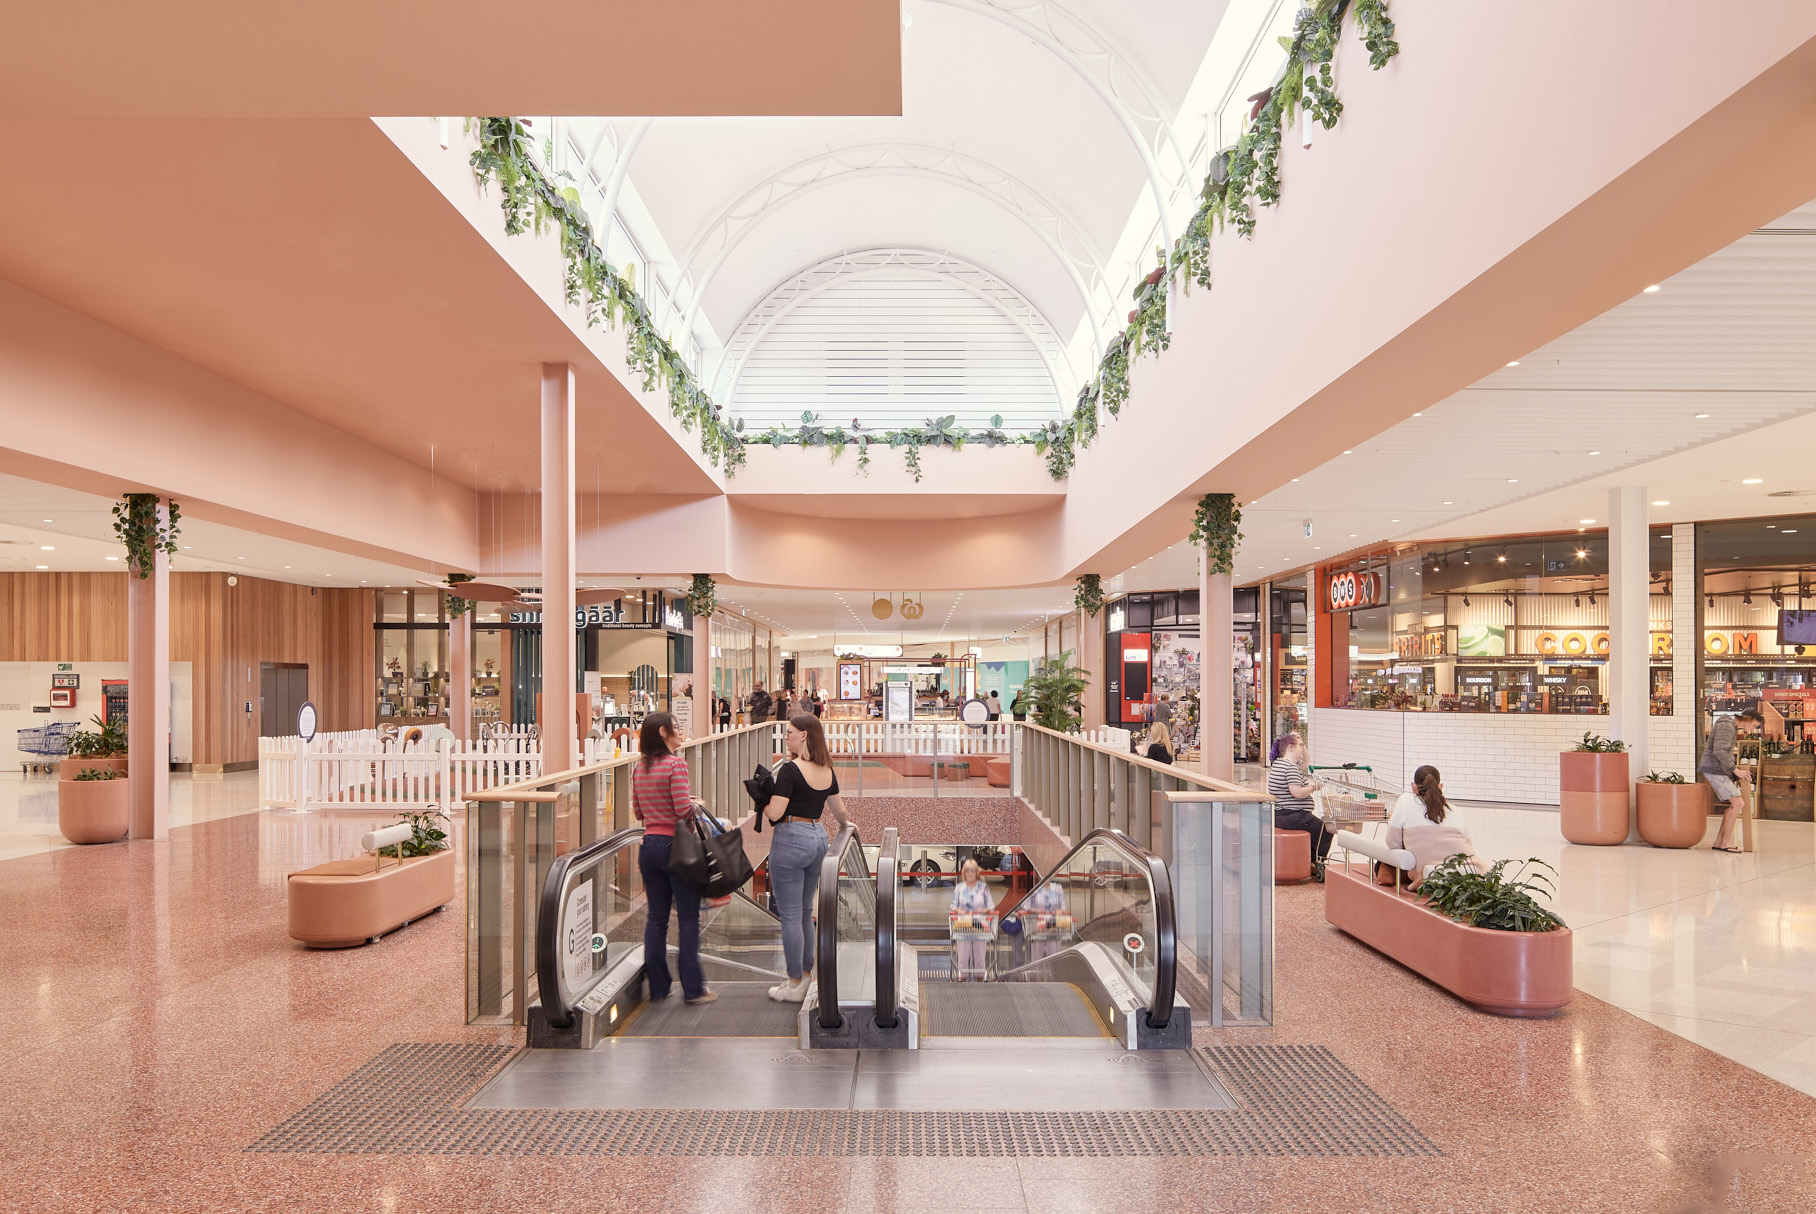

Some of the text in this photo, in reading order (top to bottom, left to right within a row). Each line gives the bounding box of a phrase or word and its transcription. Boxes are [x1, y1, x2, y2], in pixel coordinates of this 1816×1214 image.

[1649, 621, 1672, 629] NKS
[1394, 633, 1442, 656] SPIRITS
[569, 928, 575, 955] G
